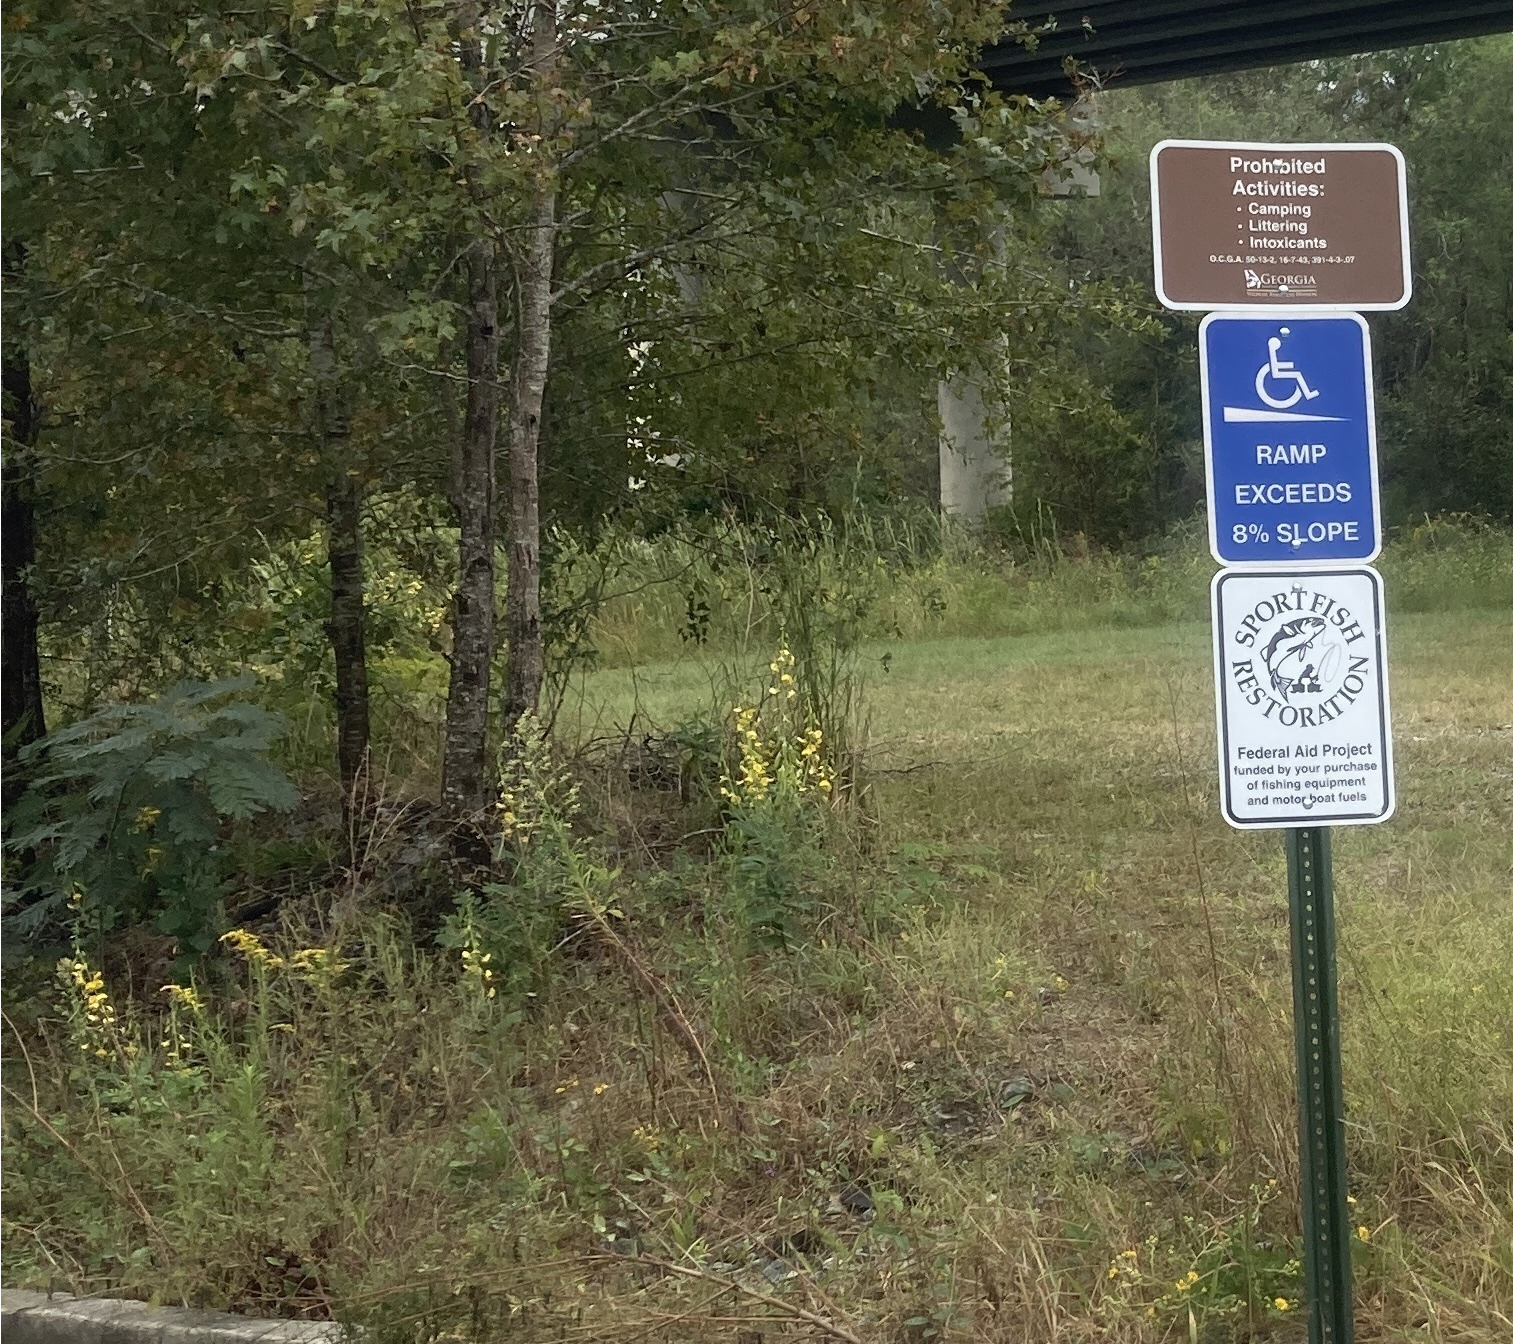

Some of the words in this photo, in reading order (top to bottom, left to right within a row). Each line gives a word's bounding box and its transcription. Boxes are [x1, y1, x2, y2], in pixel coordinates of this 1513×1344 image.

[1230, 156, 1326, 174] Prohbited
[1232, 179, 1325, 197] Activities:
[1248, 202, 1312, 218] Camping
[1248, 219, 1308, 235] Littering
[1249, 236, 1328, 249] Intoxicants
[1210, 255, 1244, 264] O.C.G.A.
[1260, 272, 1317, 285] GEORGIA
[1256, 444, 1327, 465] RAMP
[1235, 483, 1352, 504] EXCEEDS
[1232, 523, 1270, 544] 8%
[1276, 521, 1360, 543] SLOPE
[1232, 654, 1370, 728] RESTORATION
[1237, 745, 1290, 759] Federal
[1295, 744, 1318, 758] Aid
[1322, 743, 1372, 759] Project
[1234, 764, 1274, 776] funded
[1278, 764, 1291, 776] by
[1295, 765, 1320, 776] your
[1324, 761, 1378, 775] purchase
[1246, 779, 1259, 790] of
[1261, 779, 1301, 791] fishing
[1304, 777, 1366, 789] equipment
[1247, 795, 1268, 806] and
[1272, 795, 1306, 805] motor
[1309, 793, 1335, 804] boat
[1338, 792, 1367, 803] fuels
